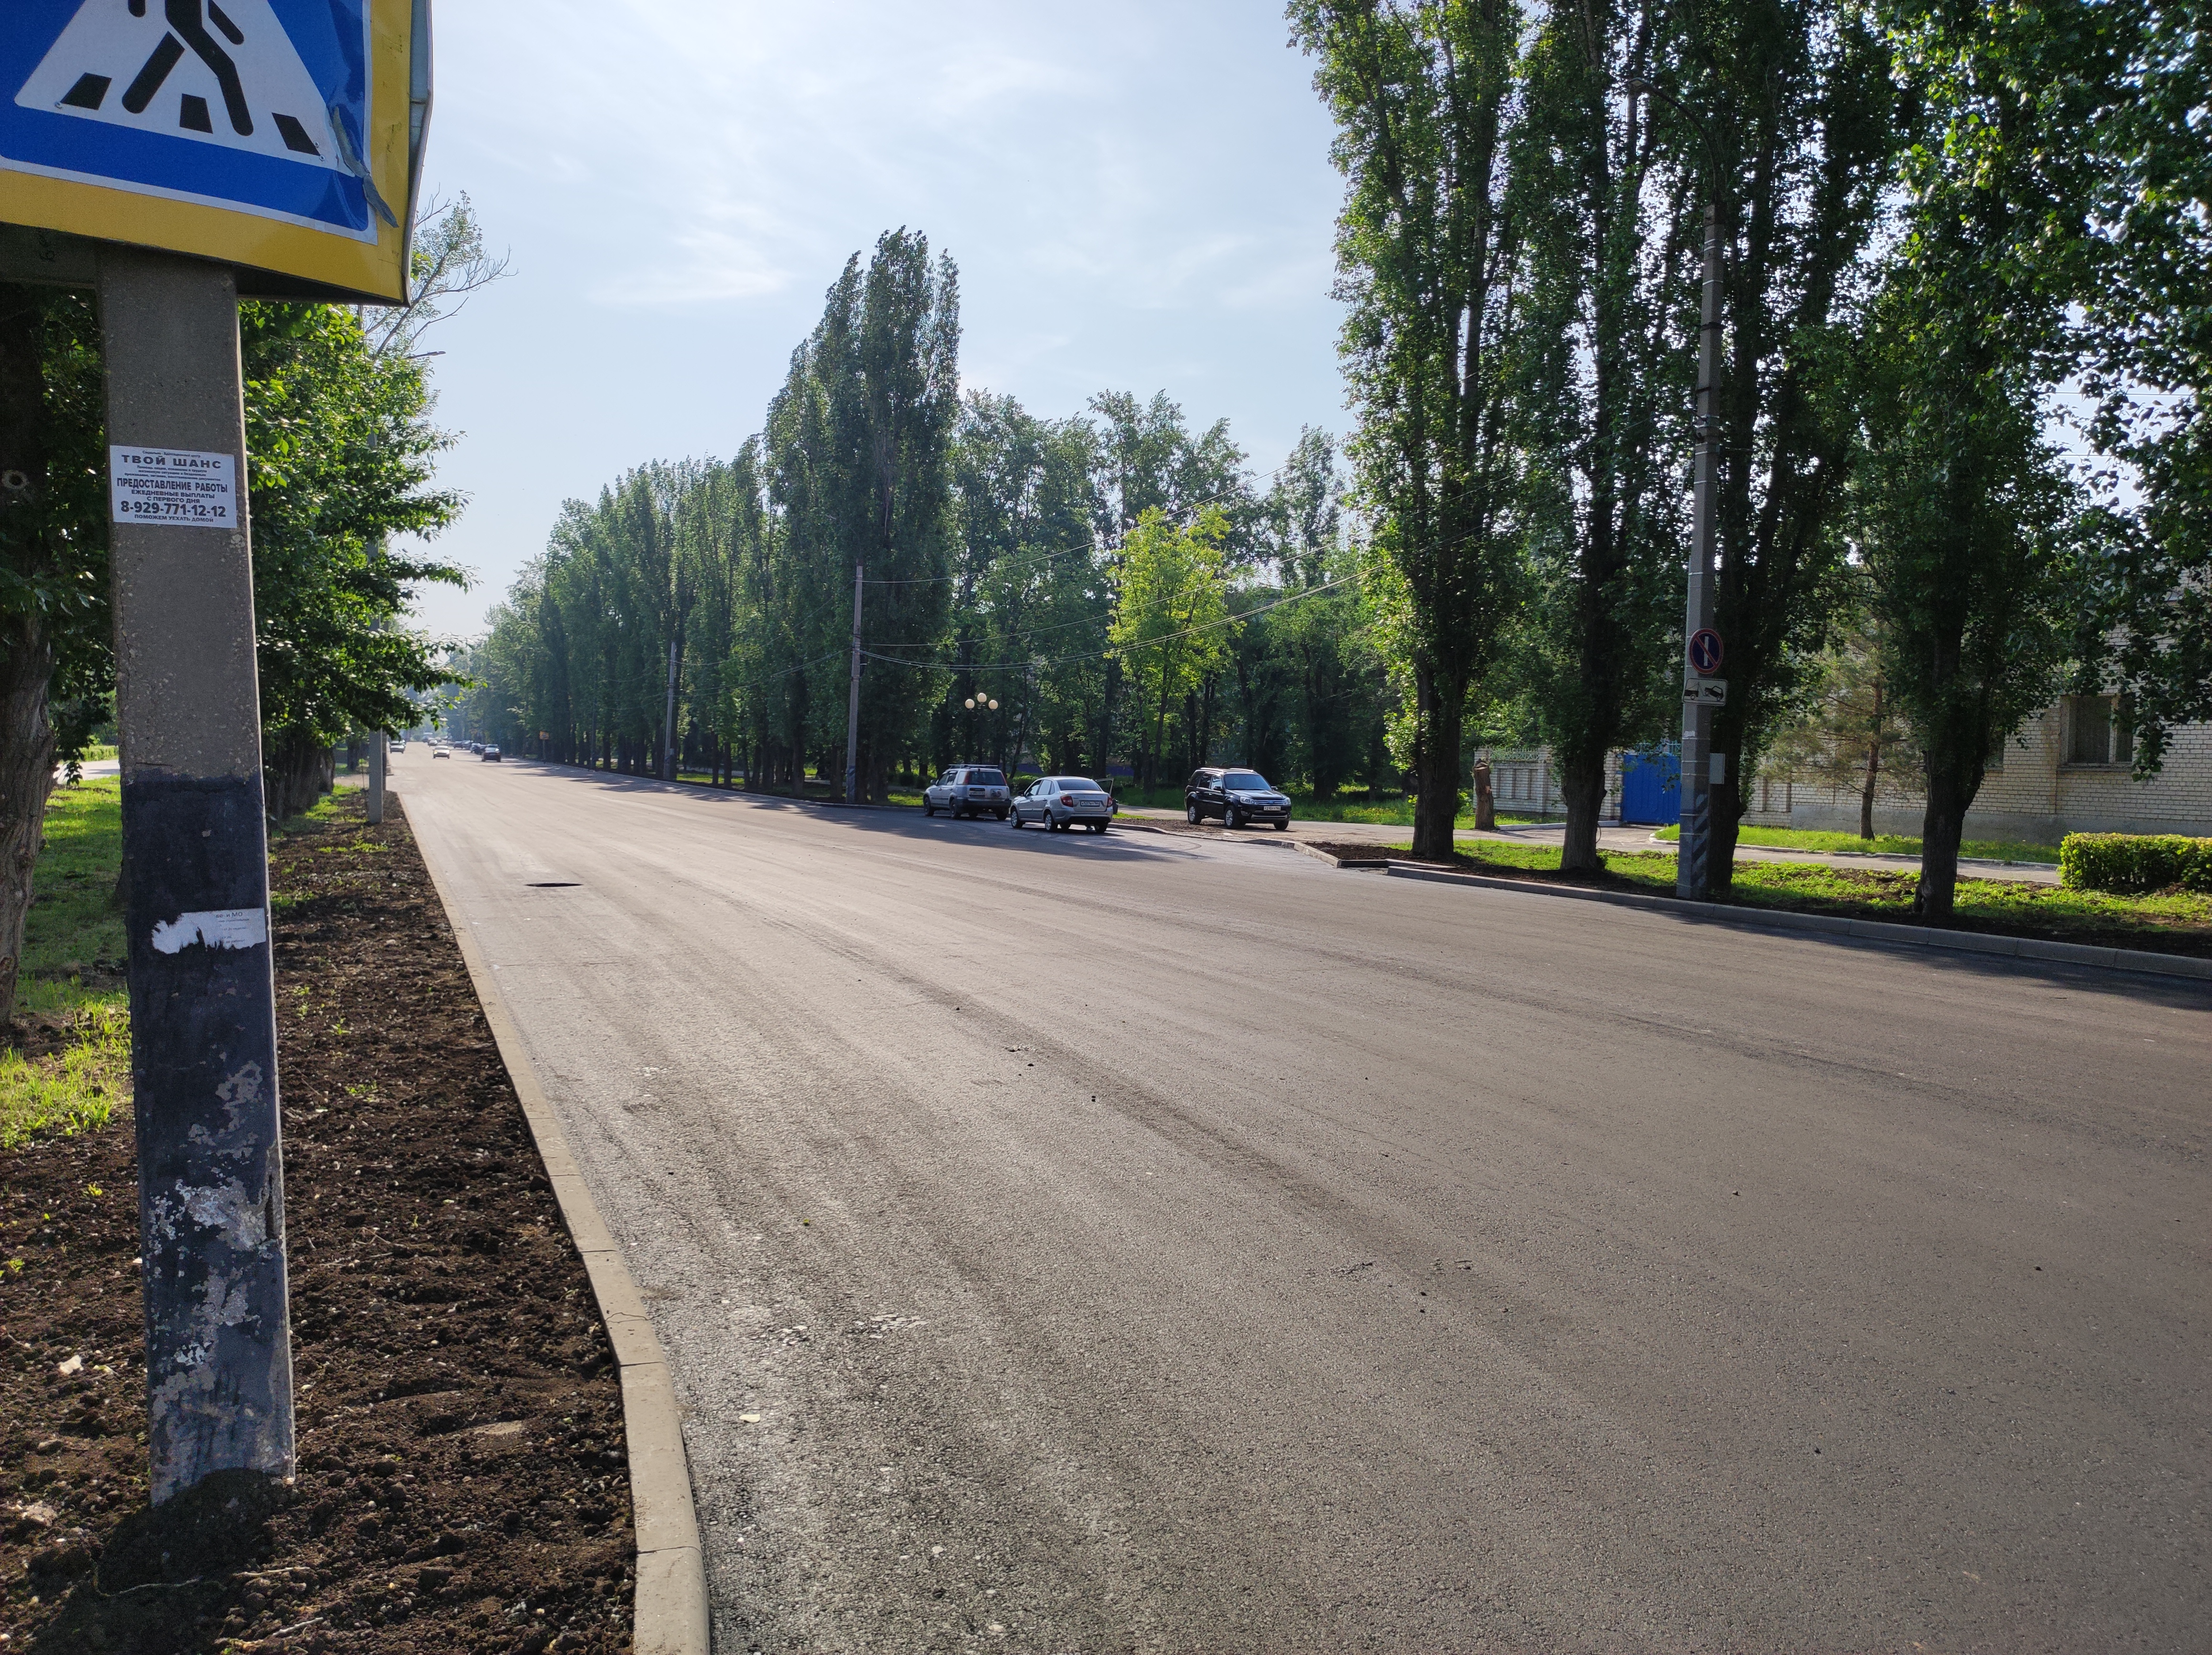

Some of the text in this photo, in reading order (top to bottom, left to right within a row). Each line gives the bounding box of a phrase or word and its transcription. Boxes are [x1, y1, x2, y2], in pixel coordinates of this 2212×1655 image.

[122, 454, 221, 469] ТВОЙ ШАНС
[117, 478, 227, 492] ПРЕДОСТАВЛЕНИЕ РАБОТЫ
[121, 501, 226, 517] 8-929-771-12-12
